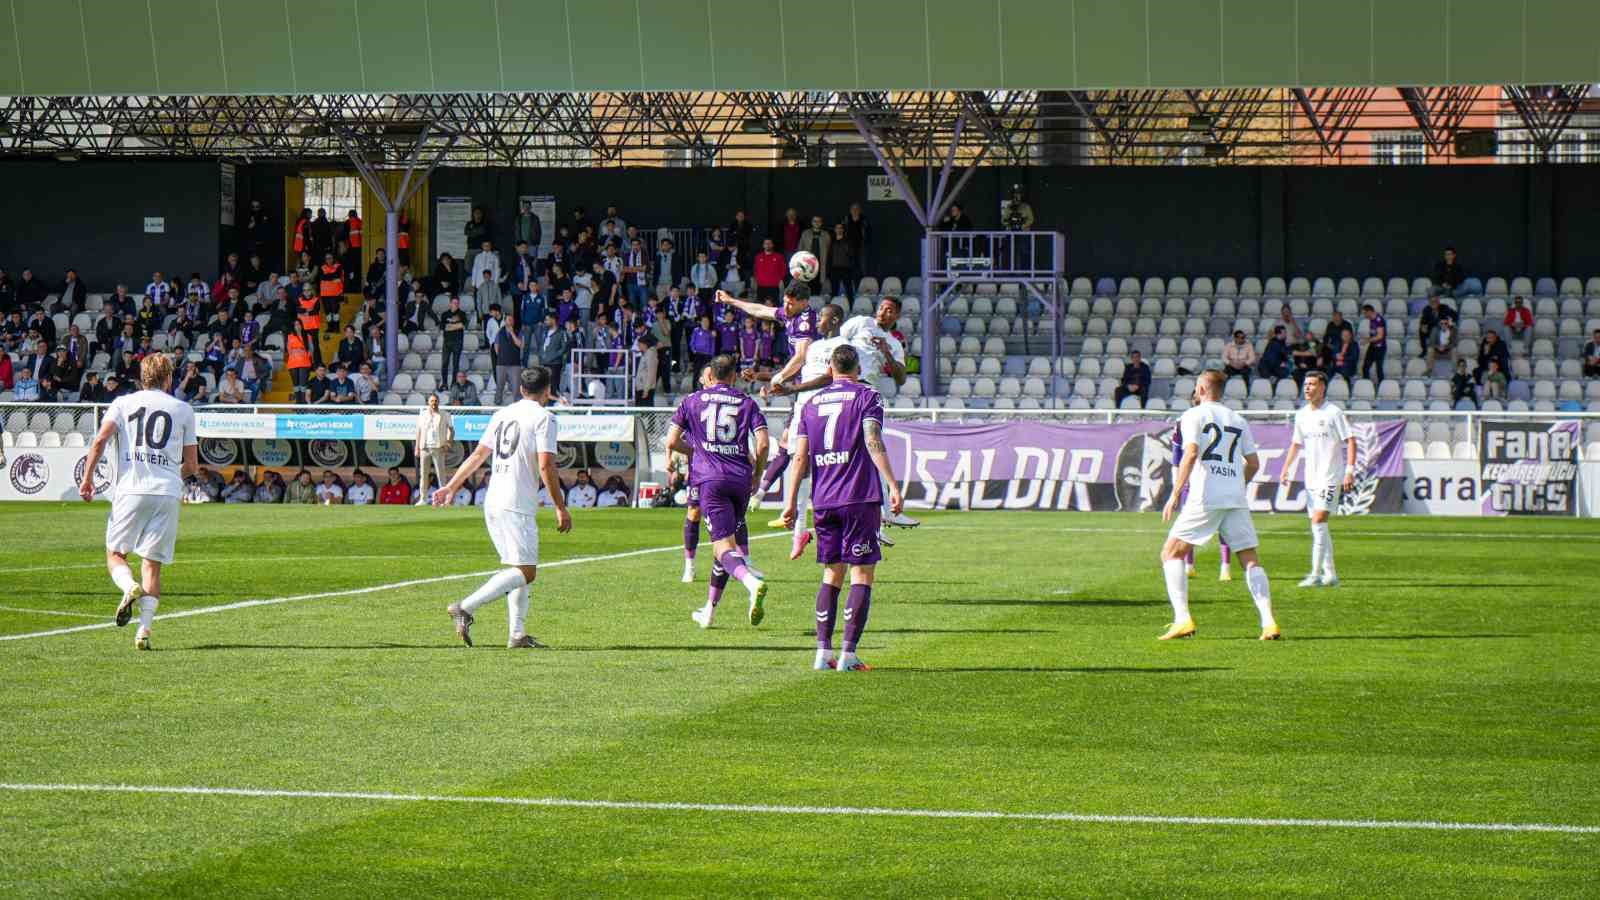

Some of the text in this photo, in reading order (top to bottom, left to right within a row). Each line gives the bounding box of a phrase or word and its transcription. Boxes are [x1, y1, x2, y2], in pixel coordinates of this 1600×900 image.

[883, 188, 893, 198] 2
[129, 406, 176, 452] 10
[494, 419, 521, 460] 19
[700, 402, 739, 443] 15
[817, 402, 843, 450] 7
[1200, 422, 1243, 463] 27
[815, 451, 849, 467] ROSHI
[904, 447, 1104, 512] SALDIR
[1319, 485, 1337, 502] 45
